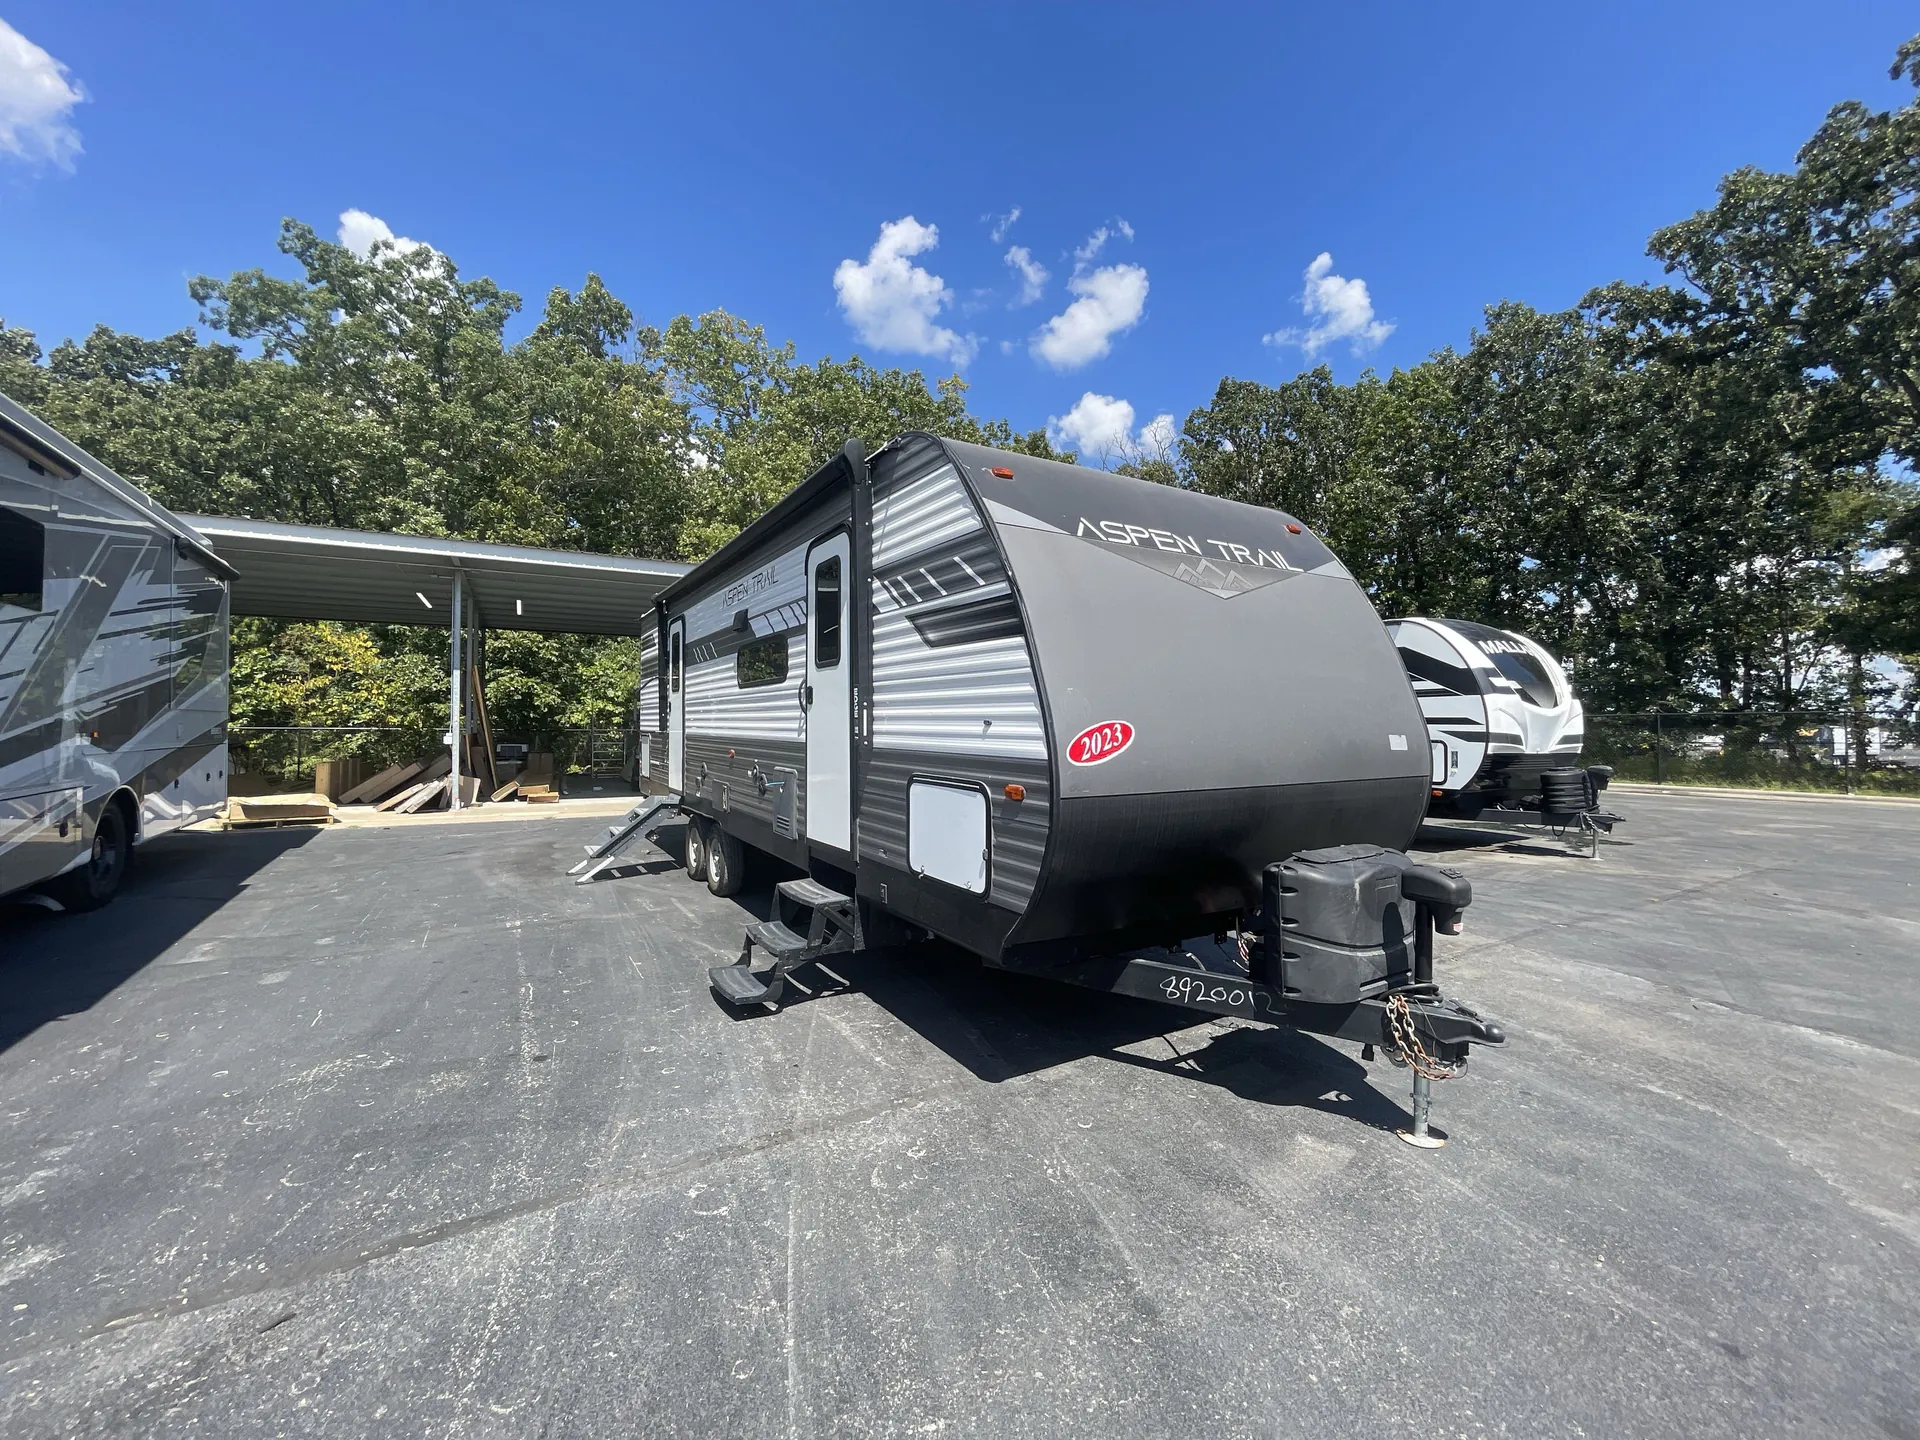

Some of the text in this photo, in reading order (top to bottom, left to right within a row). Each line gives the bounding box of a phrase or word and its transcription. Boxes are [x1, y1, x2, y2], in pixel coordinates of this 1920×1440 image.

[1077, 517, 1304, 572] ASPEN TRAIL
[721, 566, 778, 609] ASPEN TRAIL
[1080, 723, 1123, 761] 2023
